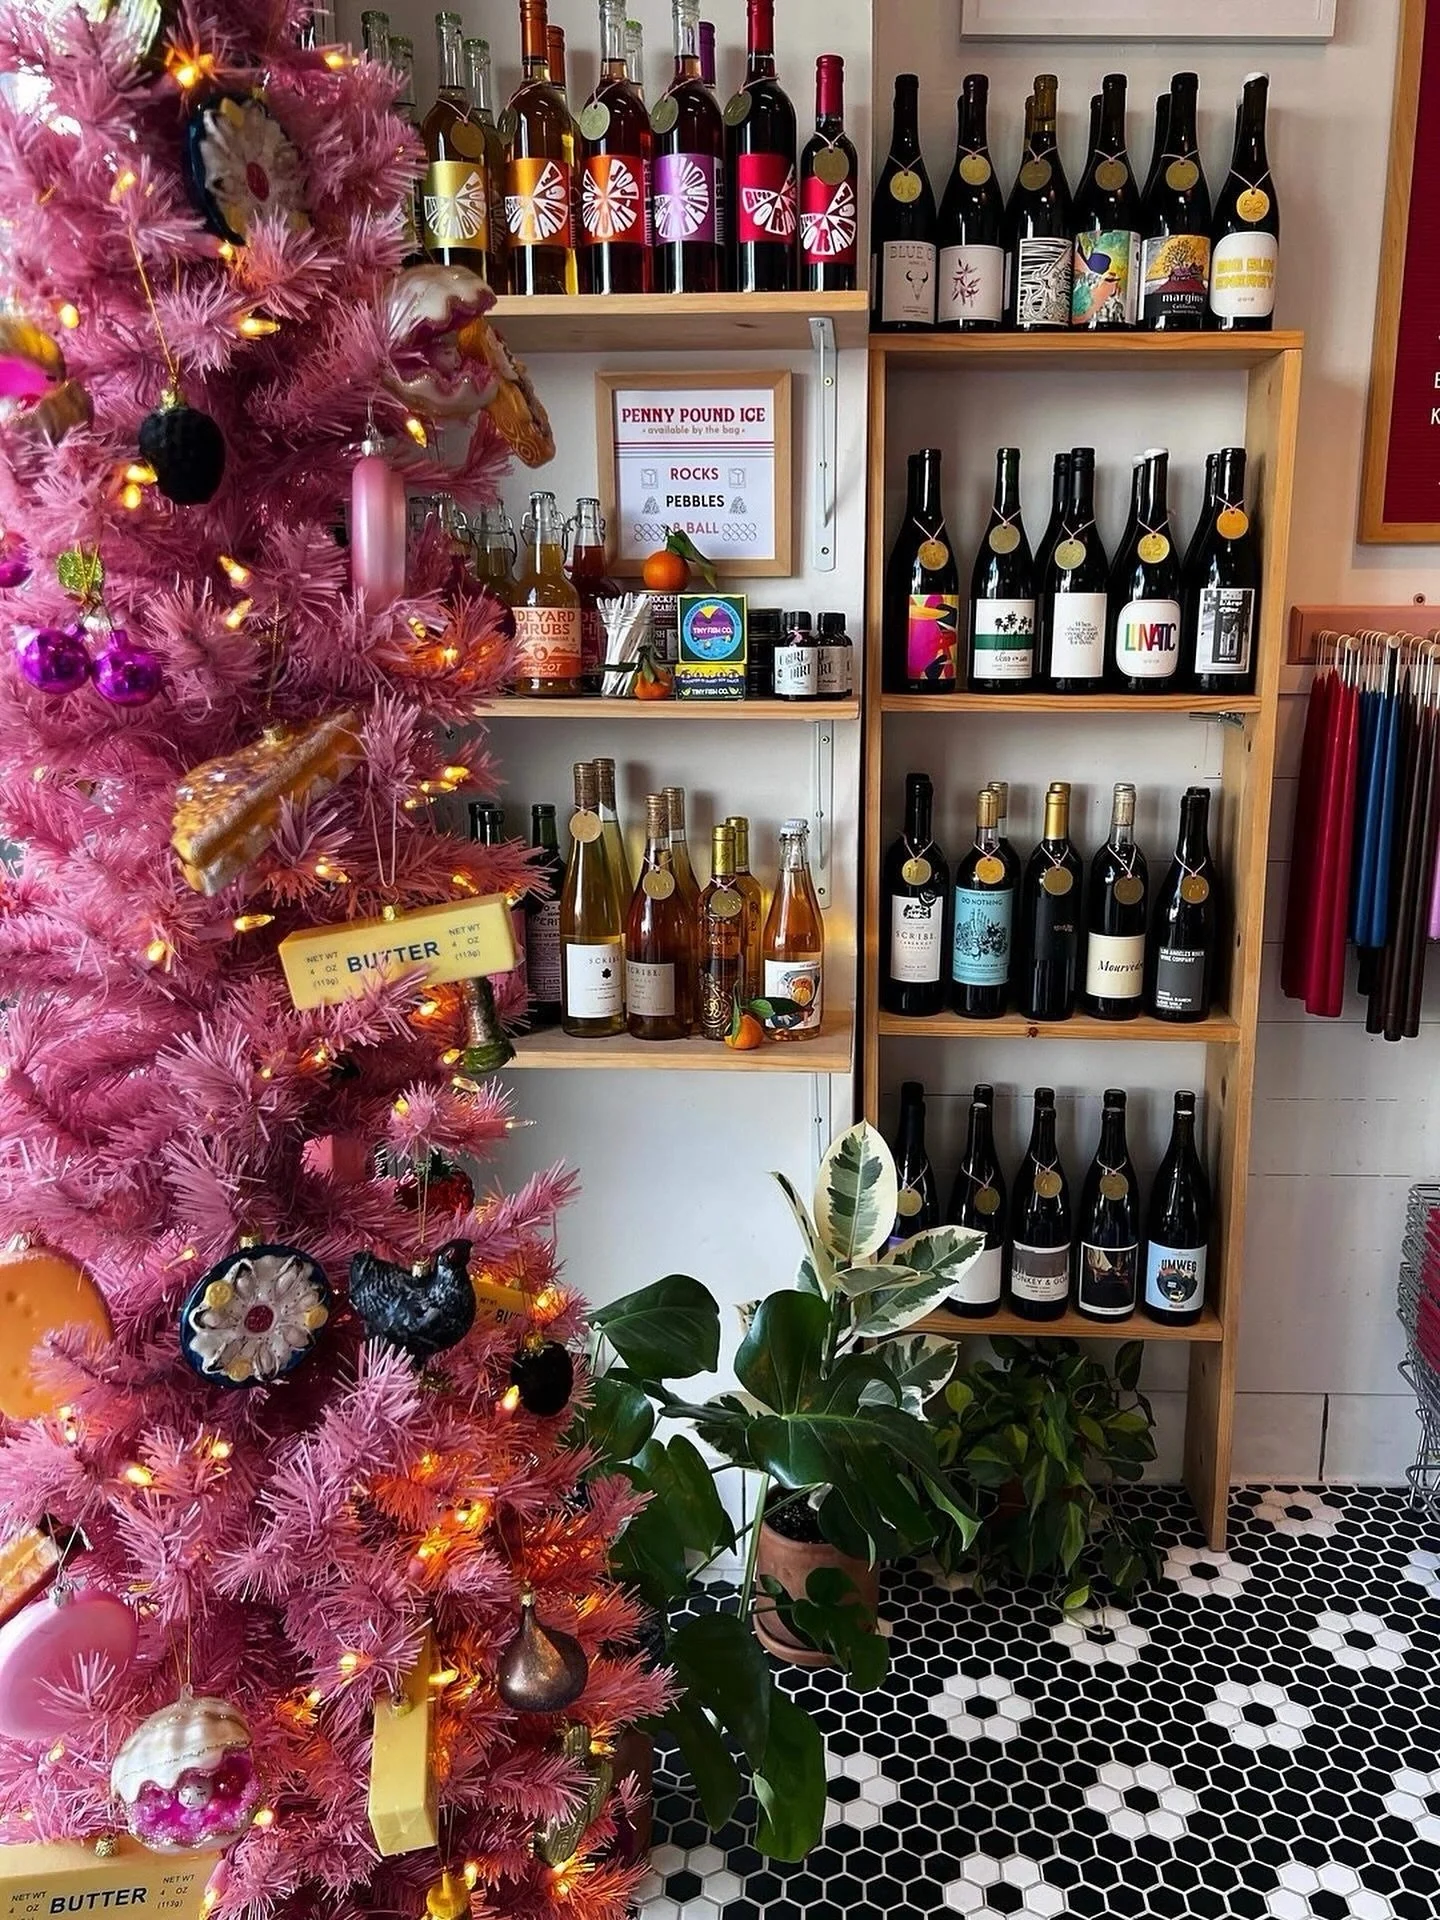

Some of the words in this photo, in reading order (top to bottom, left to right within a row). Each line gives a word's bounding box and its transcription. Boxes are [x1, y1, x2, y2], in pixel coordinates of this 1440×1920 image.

[1242, 198, 1266, 214] 52
[890, 246, 923, 259] BLUE
[1162, 293, 1203, 304] margins
[622, 408, 674, 422] PENNY
[680, 408, 735, 422] POUND
[740, 408, 765, 422] ICE
[648, 425, 689, 434] available
[692, 426, 704, 435] by
[706, 425, 720, 434] the
[722, 425, 741, 435] bag
[670, 468, 719, 480] ROCKS
[666, 495, 725, 508] PEBBLES
[686, 522, 719, 534] BALL
[515, 611, 575, 622] DEYARD
[519, 623, 570, 635] HRUBS
[1124, 623, 1176, 652] LUNATIC
[971, 898, 1003, 906] NOTHING
[449, 926, 466, 936] NET
[467, 923, 480, 932] WT
[467, 937, 479, 945] OZ
[306, 953, 324, 964] NET
[325, 952, 338, 960] WT
[325, 964, 337, 972] OZ
[1161, 1259, 1197, 1272] UMWEG
[163, 1875, 181, 1884] NET
[182, 1873, 195, 1882] WT
[12, 1893, 31, 1901] NET
[50, 1887, 147, 1914] BUTTER
[26, 1904, 39, 1912] OZ
